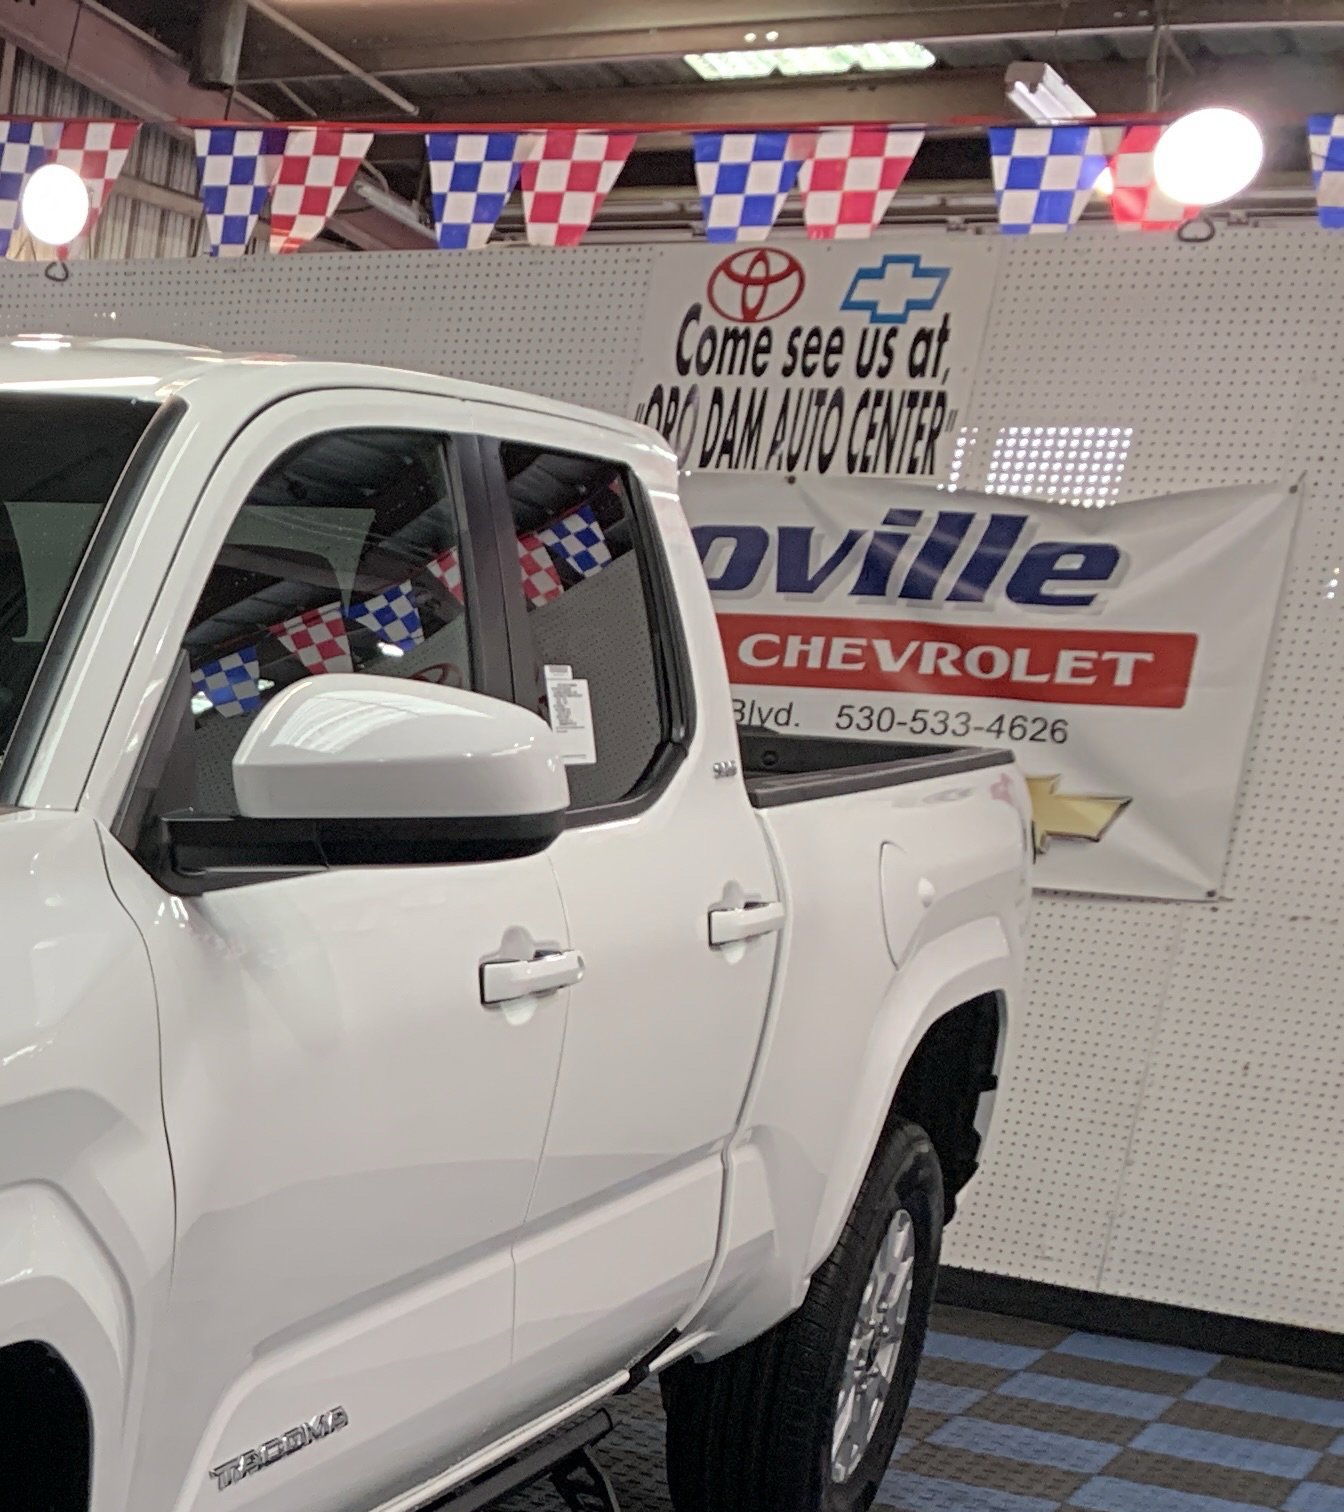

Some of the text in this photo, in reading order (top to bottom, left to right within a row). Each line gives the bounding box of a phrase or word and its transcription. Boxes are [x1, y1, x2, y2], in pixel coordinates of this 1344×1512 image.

[676, 302, 951, 385] Come see us at,
[698, 386, 768, 471] DAM
[764, 386, 845, 474] AUTO
[847, 387, 959, 475] CENTER"
[691, 508, 1121, 607] oville
[737, 632, 1154, 687] CHEVROLET
[835, 704, 1069, 745] 530-533-4626
[208, 1405, 349, 1491] TACOMA
